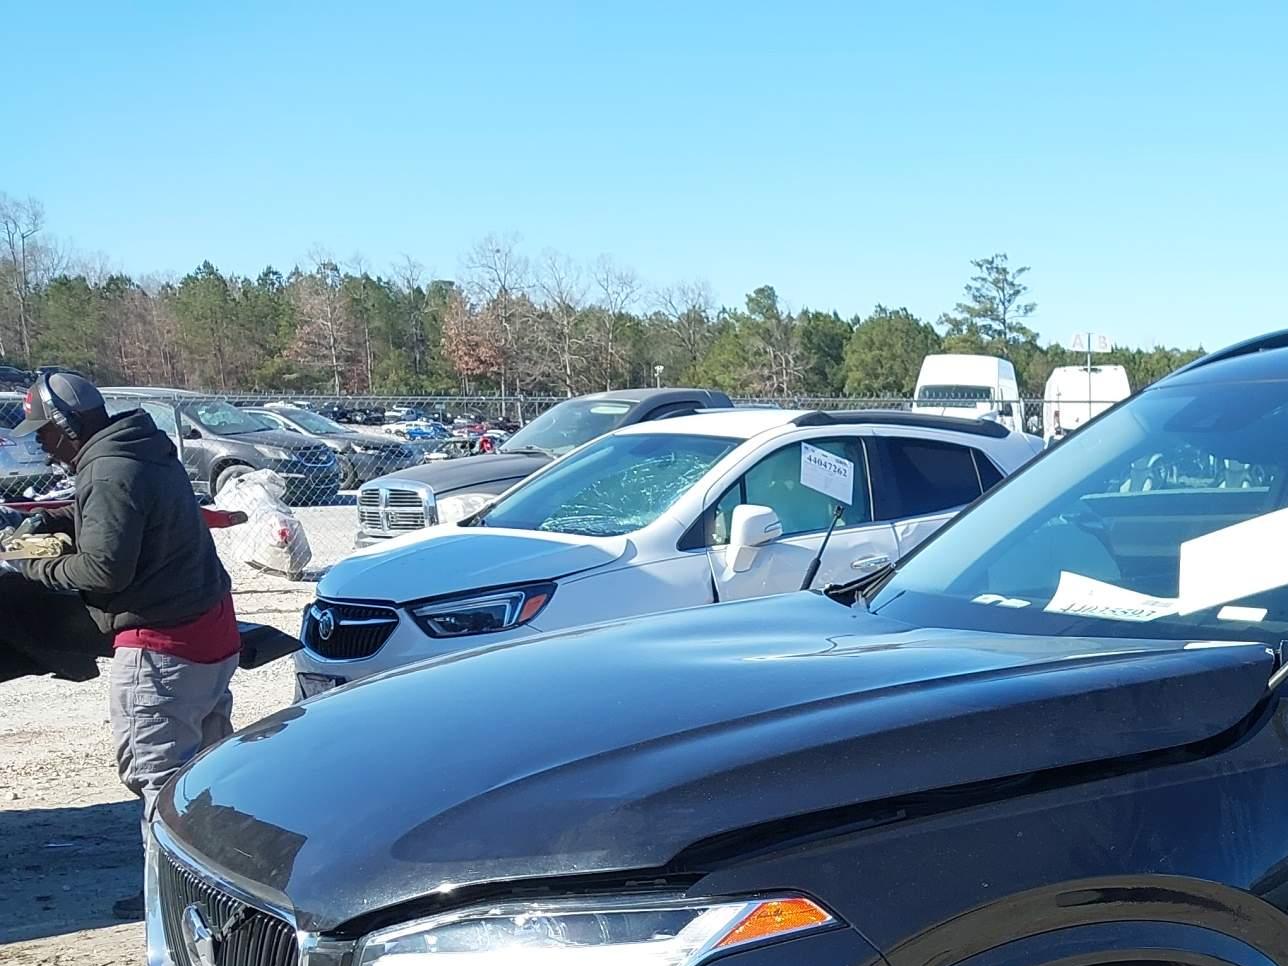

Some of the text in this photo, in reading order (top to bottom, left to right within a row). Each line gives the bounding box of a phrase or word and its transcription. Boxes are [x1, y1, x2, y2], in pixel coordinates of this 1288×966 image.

[1072, 334, 1084, 349] A
[1098, 336, 1107, 350] B
[807, 455, 847, 477] 44047262
